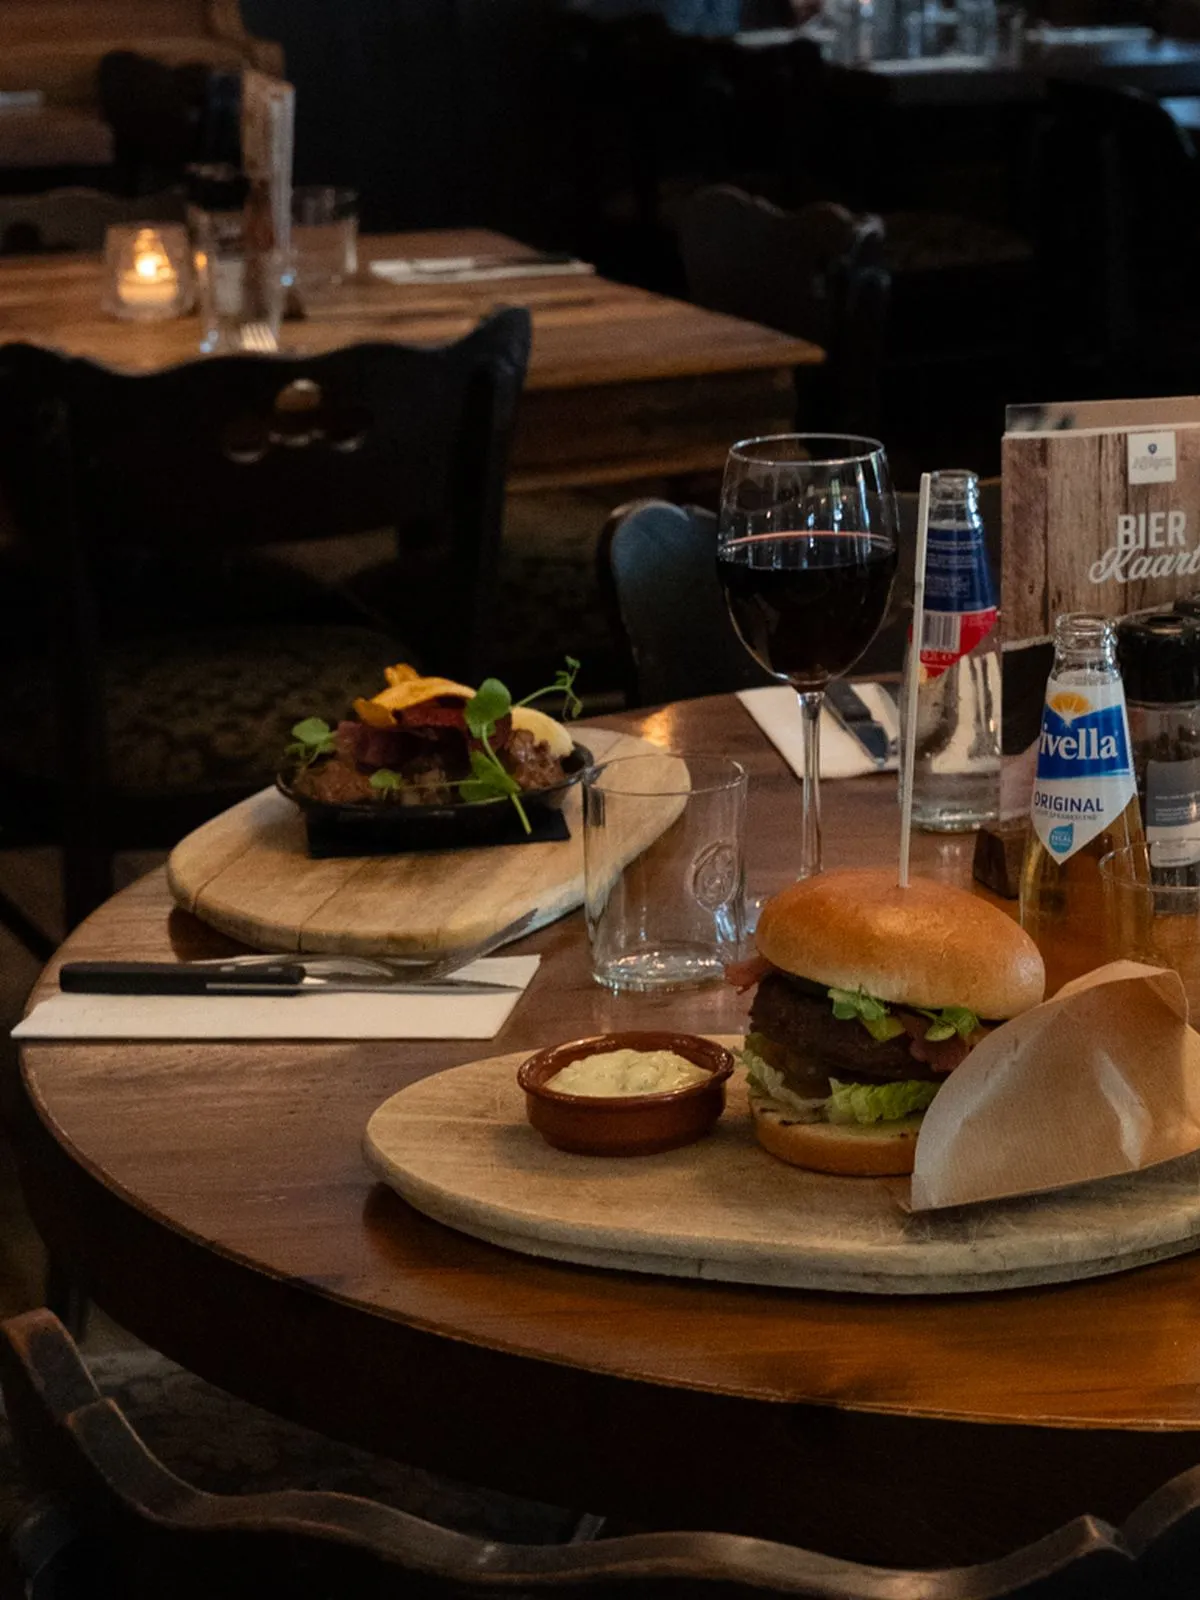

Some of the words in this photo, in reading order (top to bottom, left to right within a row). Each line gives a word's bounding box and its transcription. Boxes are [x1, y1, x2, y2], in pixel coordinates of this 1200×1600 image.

[1117, 510, 1187, 550] BIER
[1040, 722, 1119, 761] ivella
[1034, 790, 1105, 812] ORIGINAL
